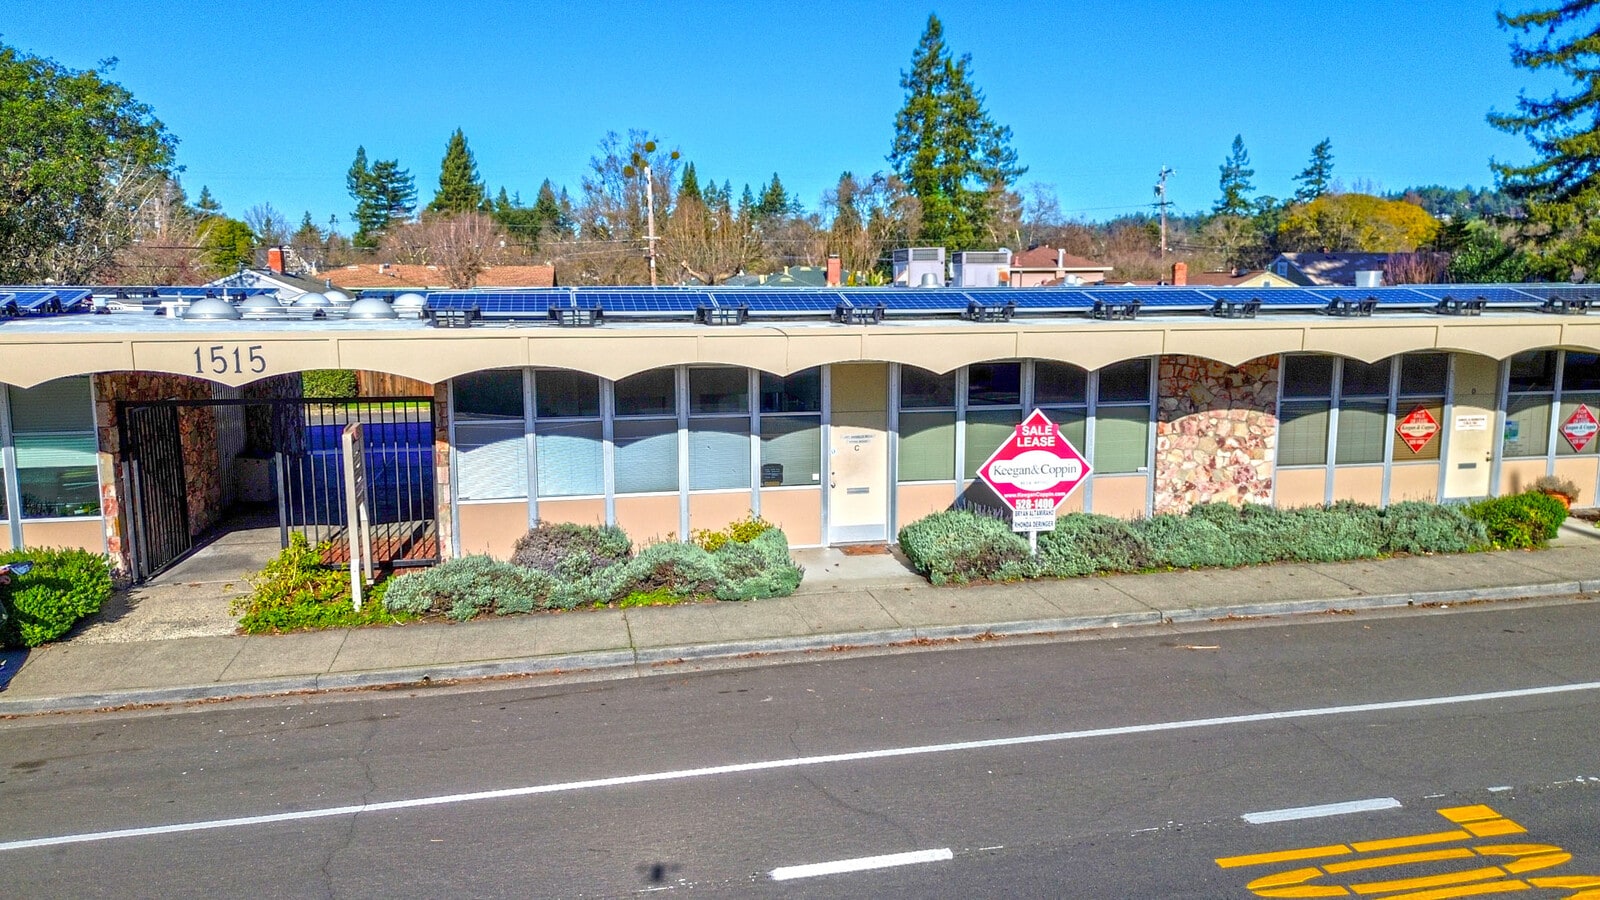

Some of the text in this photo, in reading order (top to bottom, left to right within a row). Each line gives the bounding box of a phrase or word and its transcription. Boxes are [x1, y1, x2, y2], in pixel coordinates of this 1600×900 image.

[194, 345, 266, 374] 1515
[1021, 425, 1053, 436] SALE
[1016, 436, 1056, 447] LEASE
[1015, 499, 1054, 509] 528-1400
